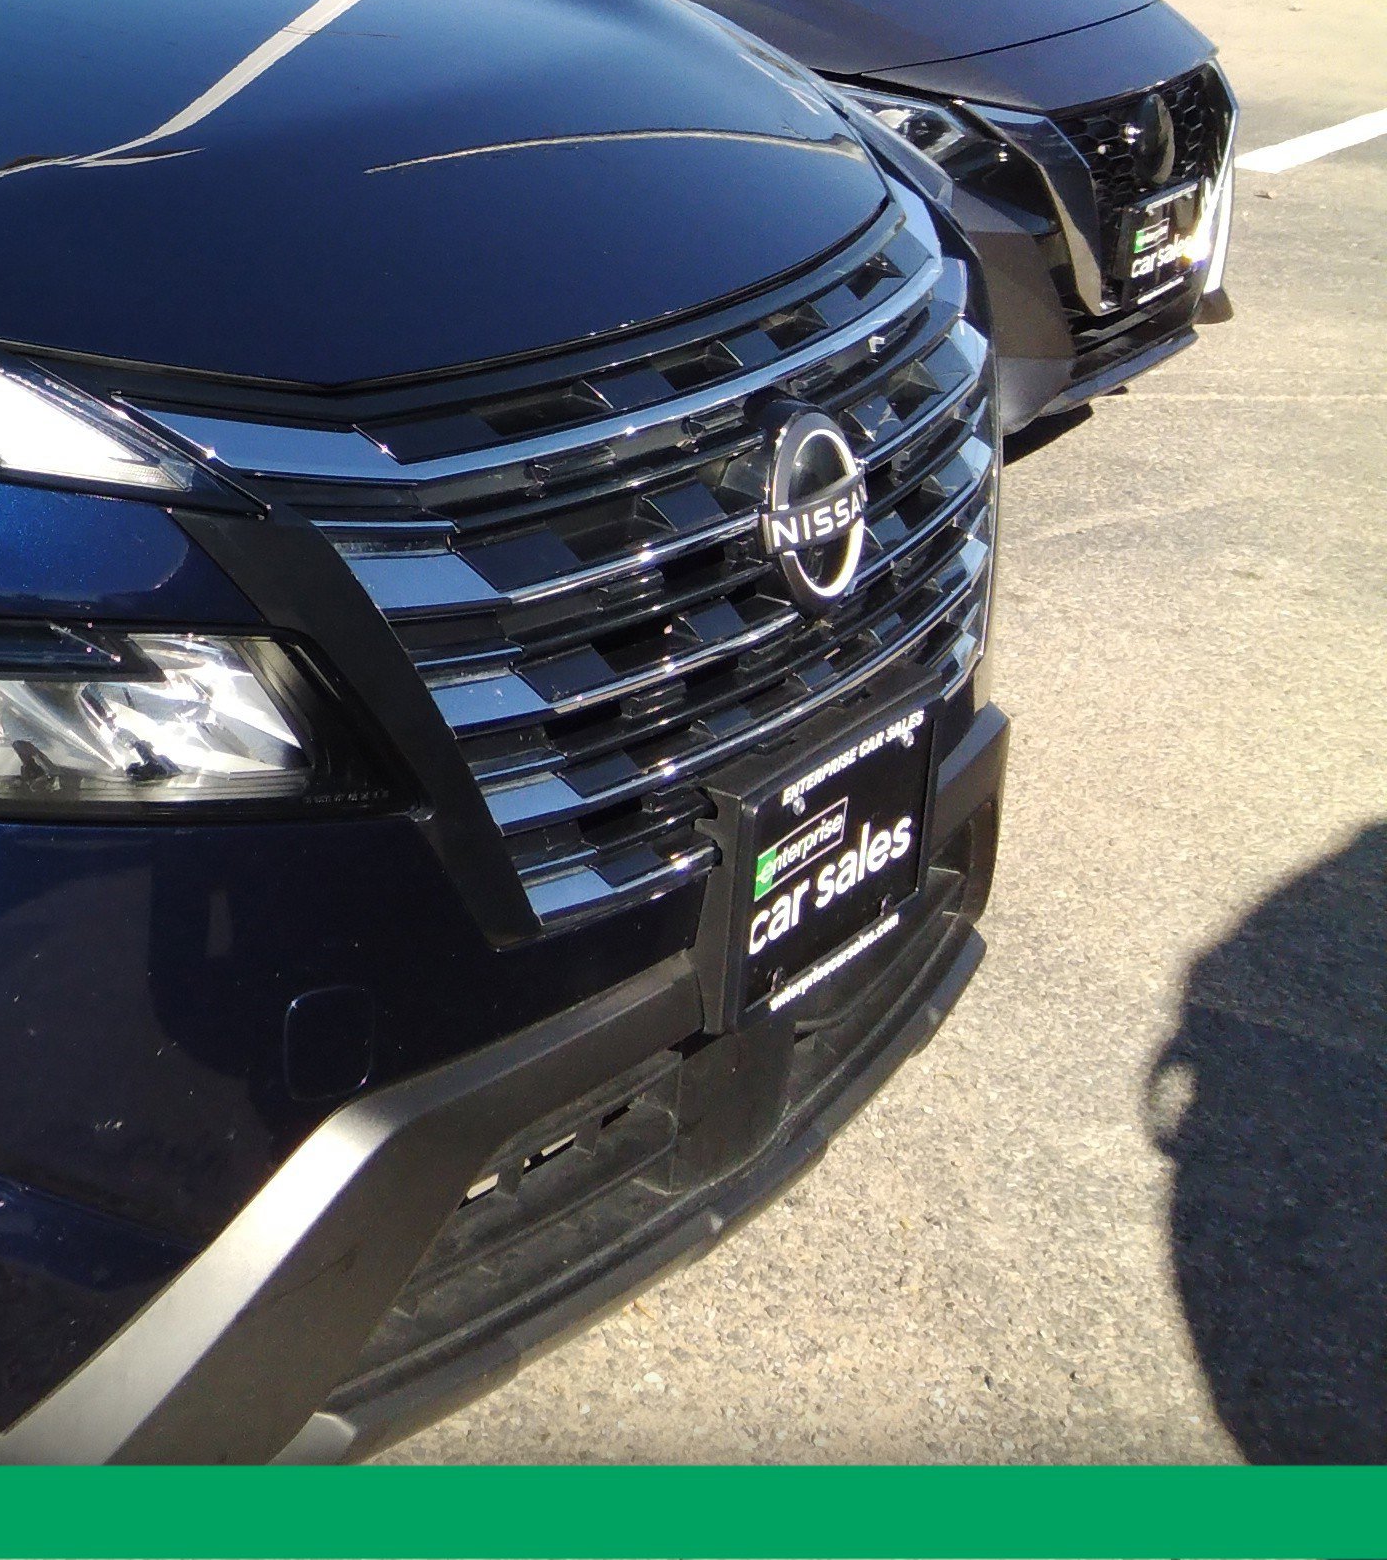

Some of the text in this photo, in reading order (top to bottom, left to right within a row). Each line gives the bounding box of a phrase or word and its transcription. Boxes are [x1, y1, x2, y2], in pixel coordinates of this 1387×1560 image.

[779, 708, 926, 806] ENTERPRISE CAR SALES
[748, 815, 914, 956] car sales
[756, 812, 844, 885] enterprise
